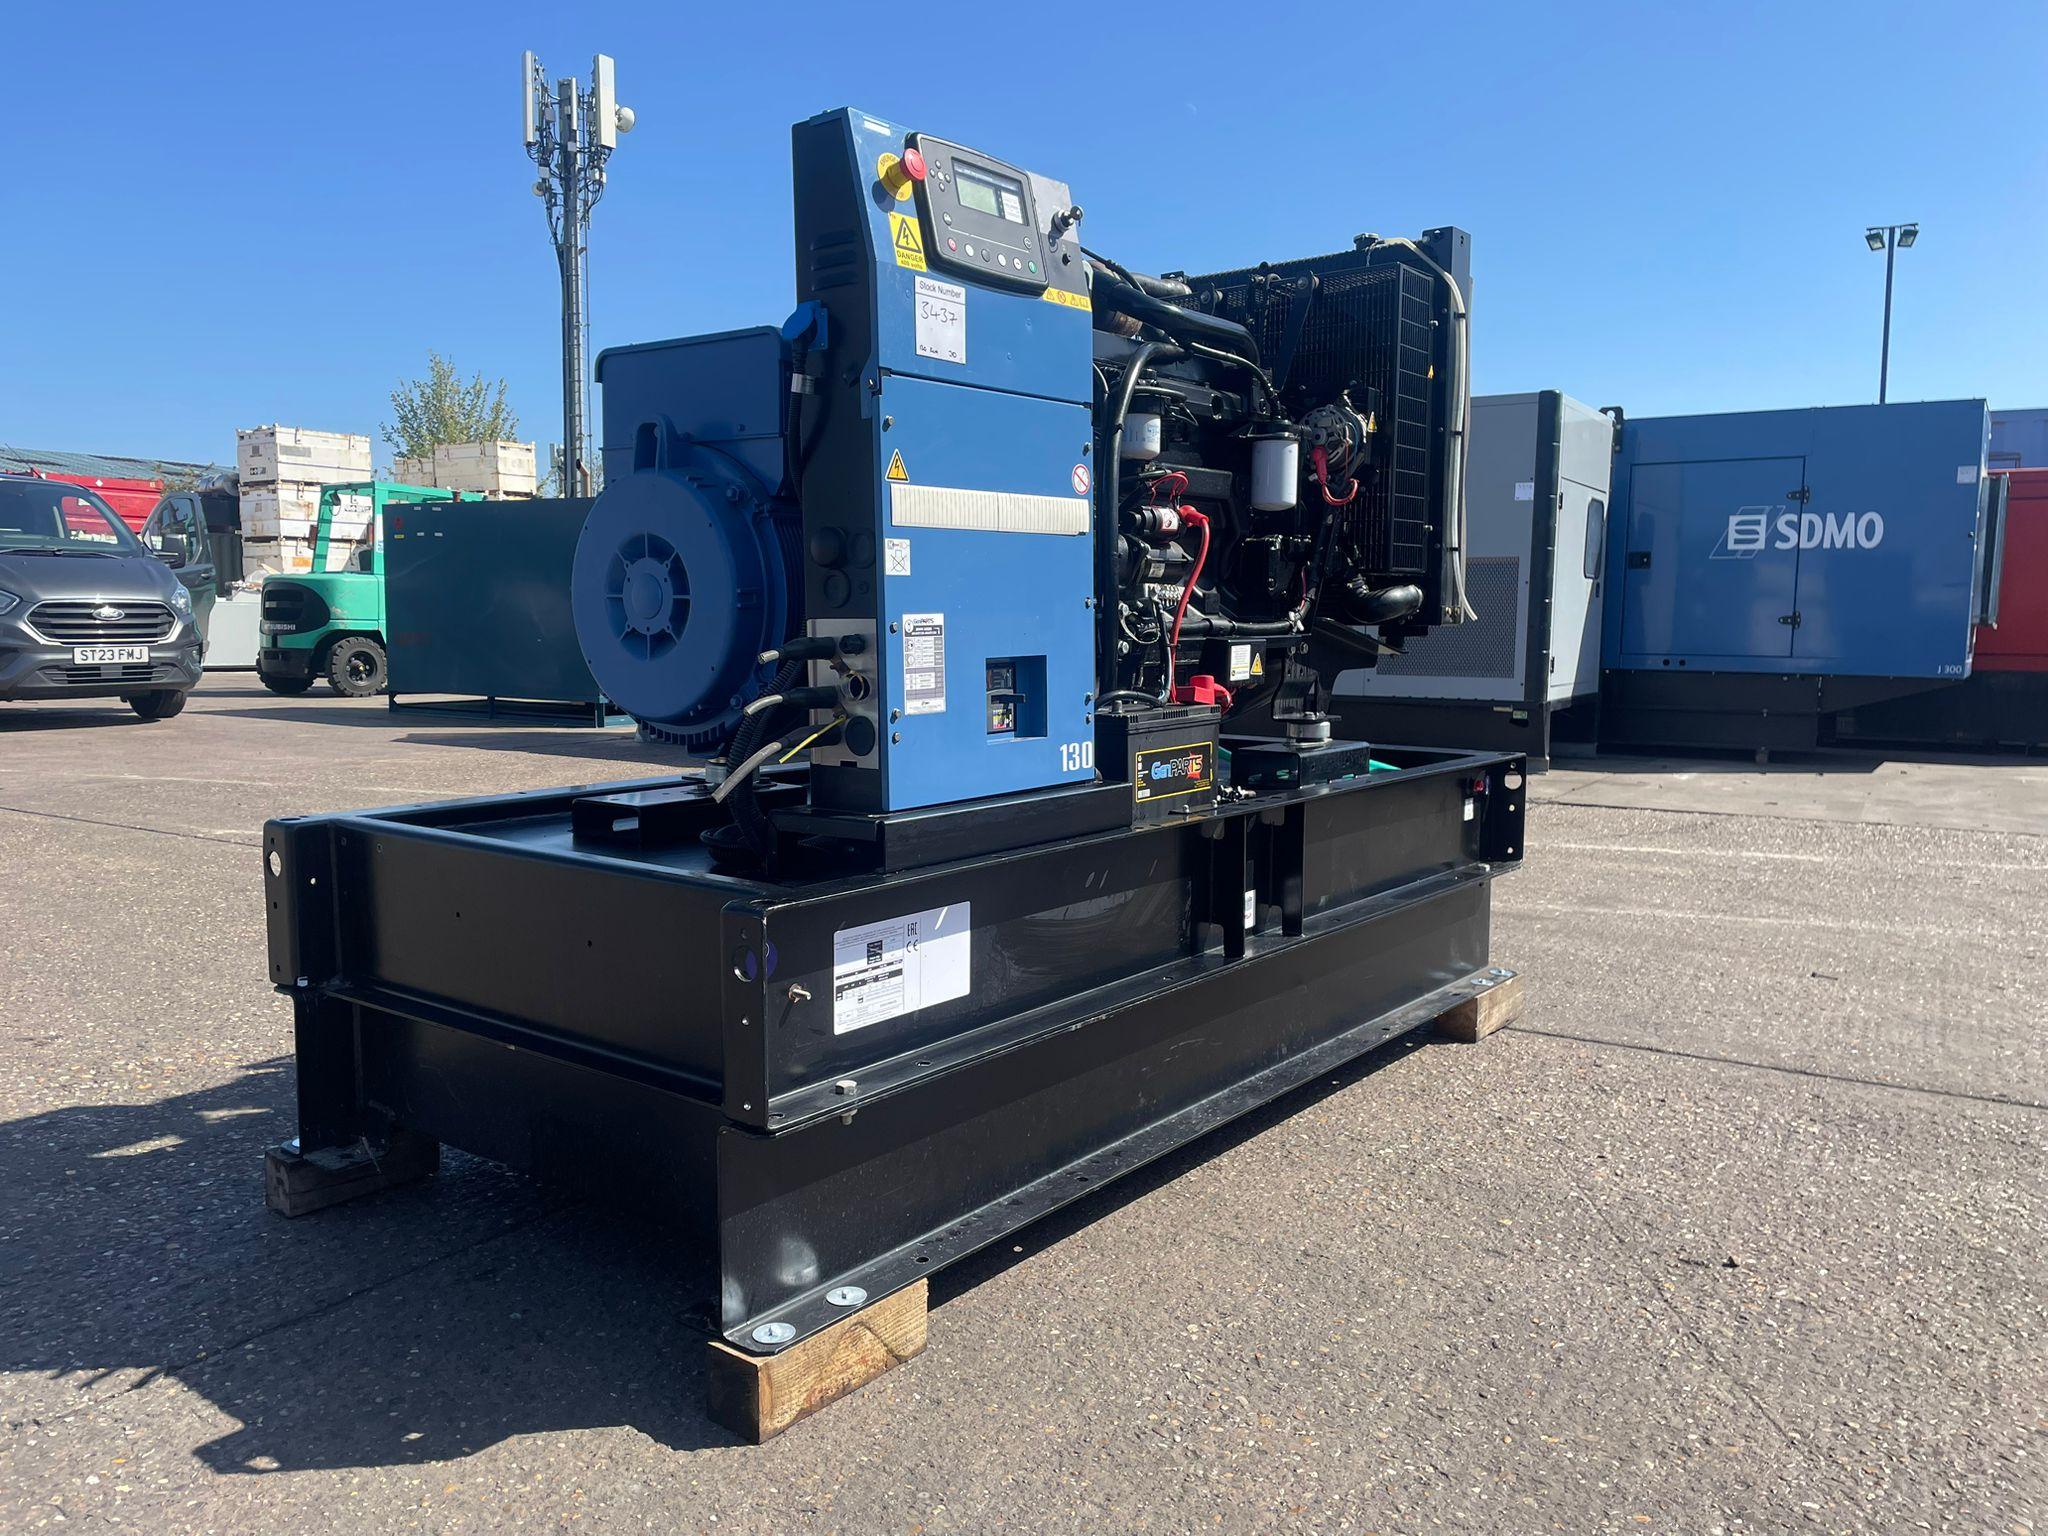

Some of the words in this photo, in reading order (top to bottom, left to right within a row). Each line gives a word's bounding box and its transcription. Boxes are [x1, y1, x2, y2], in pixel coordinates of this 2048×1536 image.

[896, 250, 924, 264] DANGER
[920, 280, 936, 293] Stock
[938, 285, 961, 299] Number
[920, 301, 958, 326] 3437
[1774, 511, 1884, 550] SDMO
[80, 649, 115, 661] ST23
[118, 648, 143, 660] FMJ
[1944, 664, 1963, 675] 300
[1059, 741, 1093, 772] 130
